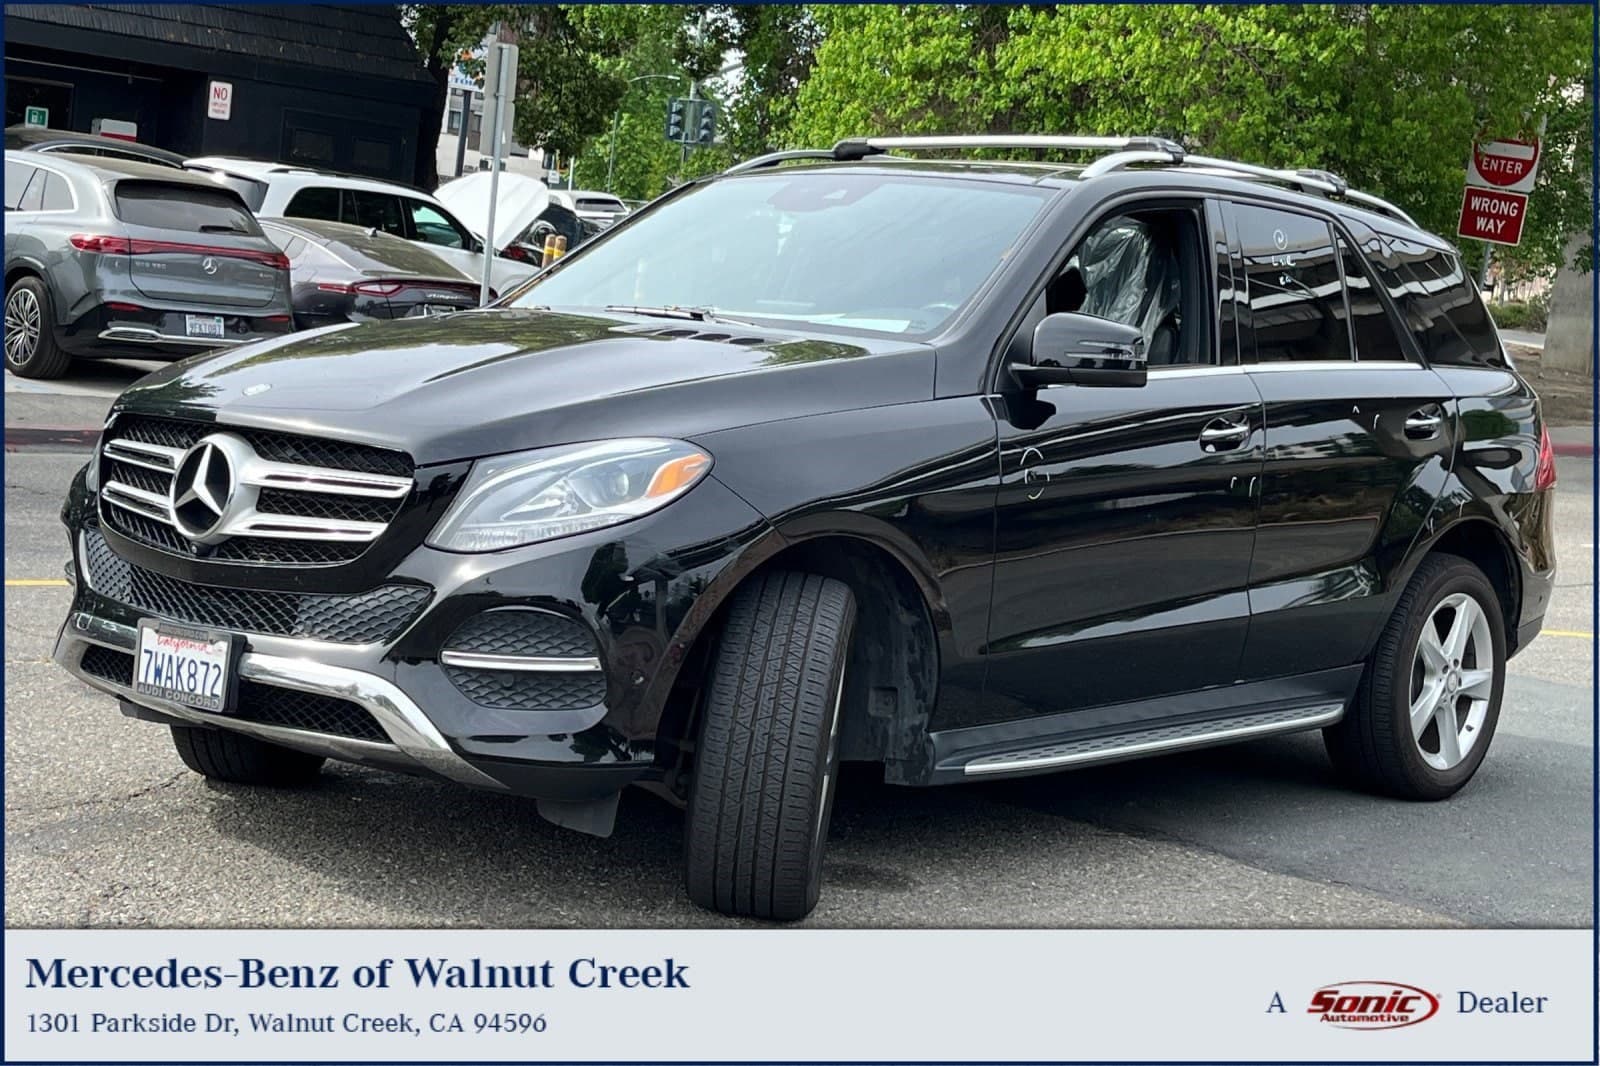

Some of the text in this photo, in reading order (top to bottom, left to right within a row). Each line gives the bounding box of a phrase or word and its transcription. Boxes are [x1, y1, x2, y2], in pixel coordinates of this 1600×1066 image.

[213, 86, 228, 101] NO
[1481, 157, 1523, 175] ENTER
[1471, 195, 1519, 217] WRONG
[1476, 215, 1507, 234] WAY
[156, 634, 214, 655] California
[143, 648, 222, 698] 7WAK872
[138, 682, 220, 709] AUDI CONCORD
